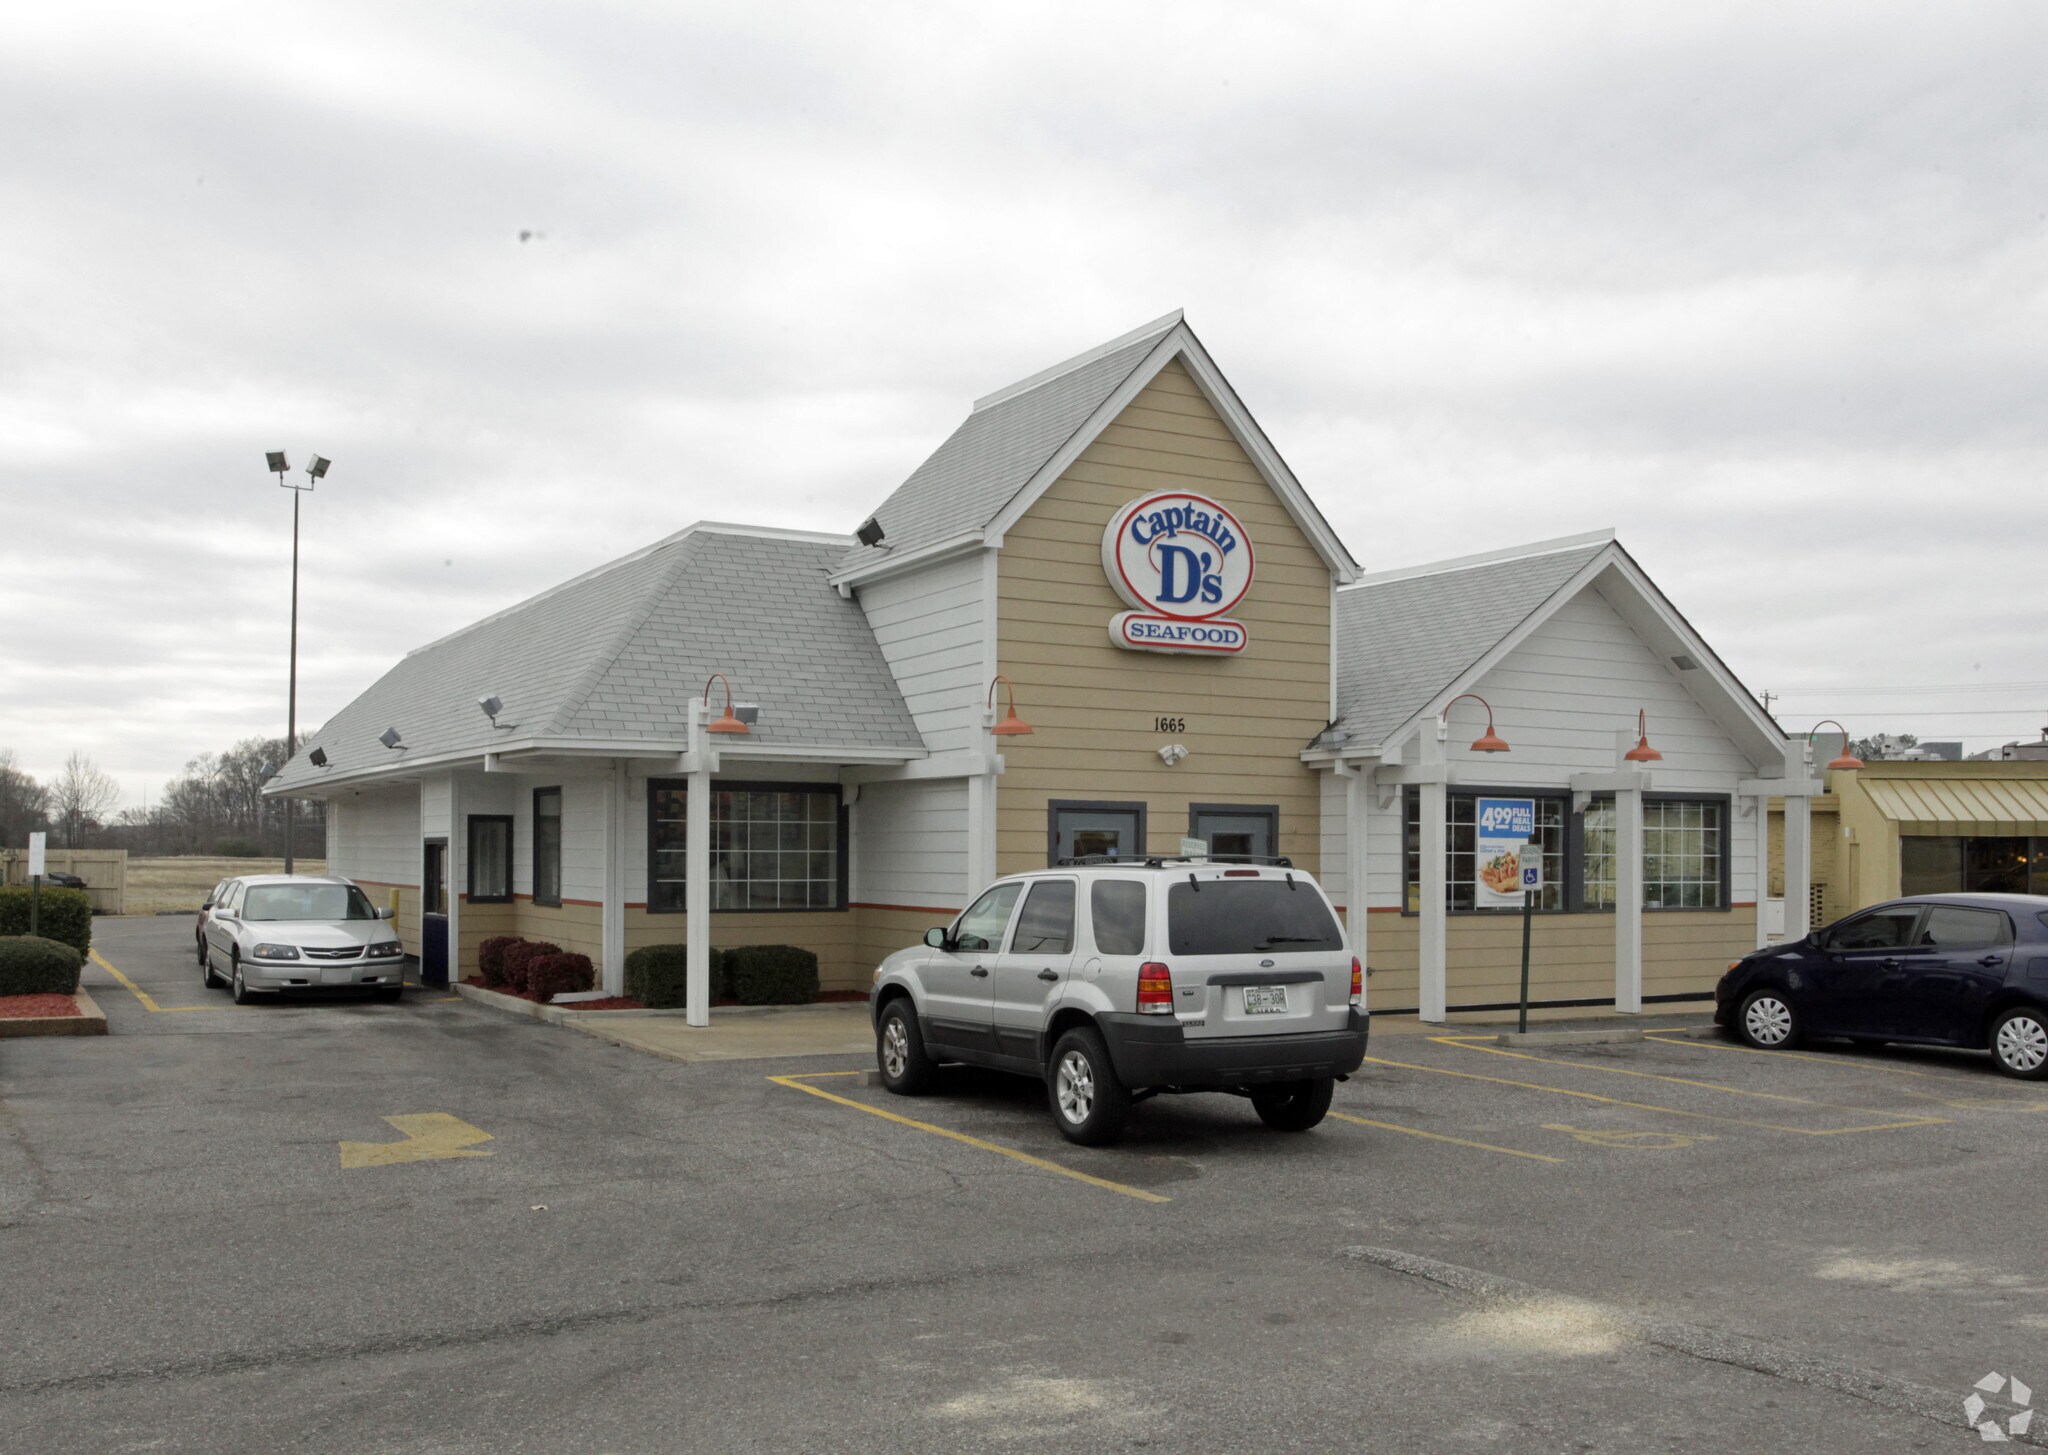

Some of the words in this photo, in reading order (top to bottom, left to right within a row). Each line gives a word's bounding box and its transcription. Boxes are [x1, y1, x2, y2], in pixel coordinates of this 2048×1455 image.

[1131, 501, 1236, 556] Captain
[1155, 543, 1223, 604] D's
[1131, 622, 1239, 644] SEAFOOD
[1154, 716, 1186, 733] 1665
[1512, 807, 1531, 817] FULL
[1512, 816, 1531, 825] MEAL
[1511, 824, 1531, 832] DEALS
